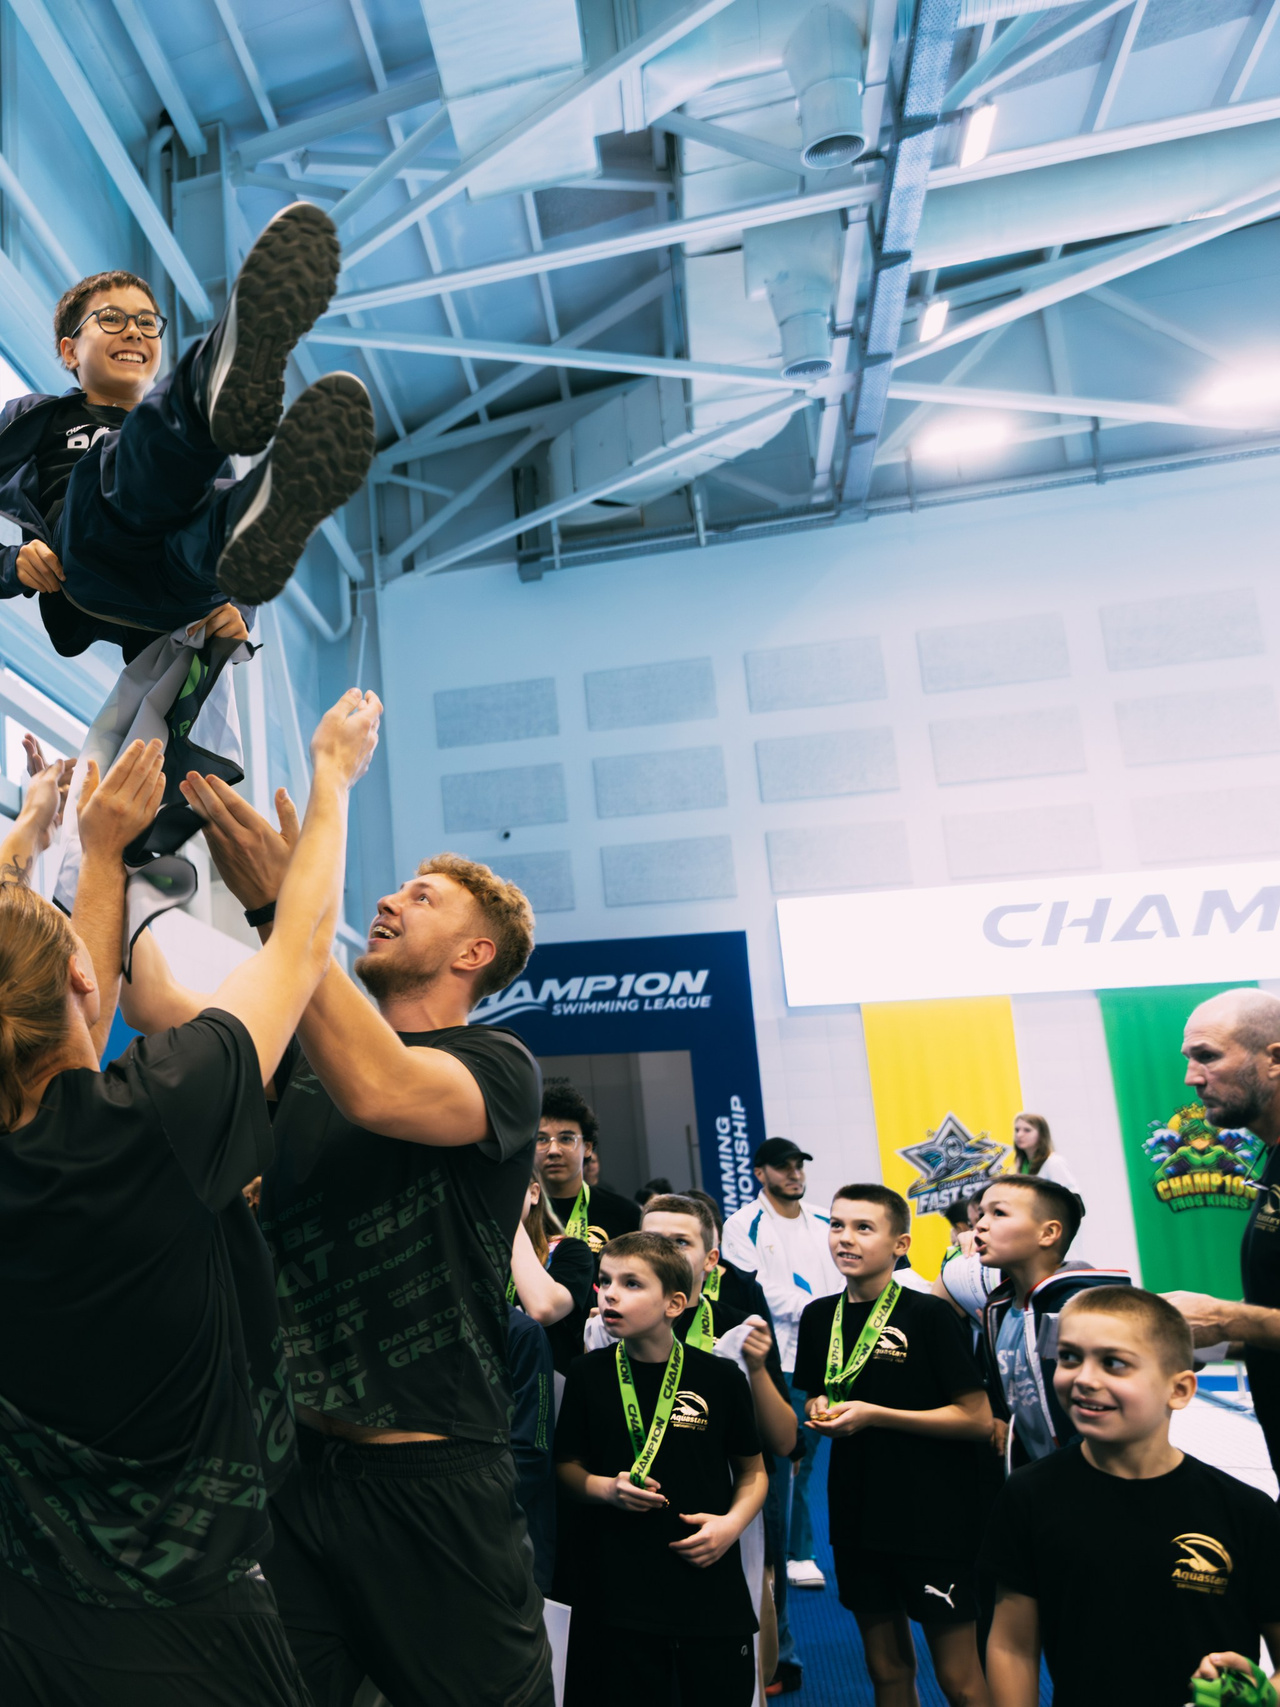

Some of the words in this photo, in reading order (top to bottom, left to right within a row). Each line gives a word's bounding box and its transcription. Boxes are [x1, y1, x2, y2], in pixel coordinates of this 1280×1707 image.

[982, 885, 1280, 948] CHAM
[487, 969, 709, 1005] AMP1ON
[552, 999, 639, 1016] SWIMMING
[644, 995, 712, 1011] LEAGUE
[716, 1116, 739, 1218] IMMING
[730, 1095, 755, 1209] IONSHIP
[348, 1199, 393, 1231] DARE
[396, 1185, 417, 1203] TO
[354, 1181, 448, 1248] GREAT
[920, 1186, 960, 1212] FAST
[1205, 1194, 1249, 1209] KINGS
[294, 1288, 332, 1314] DARE
[334, 1278, 354, 1293] TO
[357, 1265, 381, 1283] BE
[382, 1233, 434, 1270] GREAT
[393, 1269, 452, 1308] GREAT
[315, 1311, 333, 1328] TO
[336, 1296, 361, 1318] BE
[873, 1281, 900, 1328] CHAMP1
[378, 1318, 430, 1353] DARE
[433, 1306, 459, 1325] TO
[295, 1370, 325, 1386] TO
[329, 1353, 359, 1379] BE
[663, 1345, 682, 1399] CHAMP
[627, 1404, 644, 1450] CHAM
[228, 1461, 257, 1478] TO
